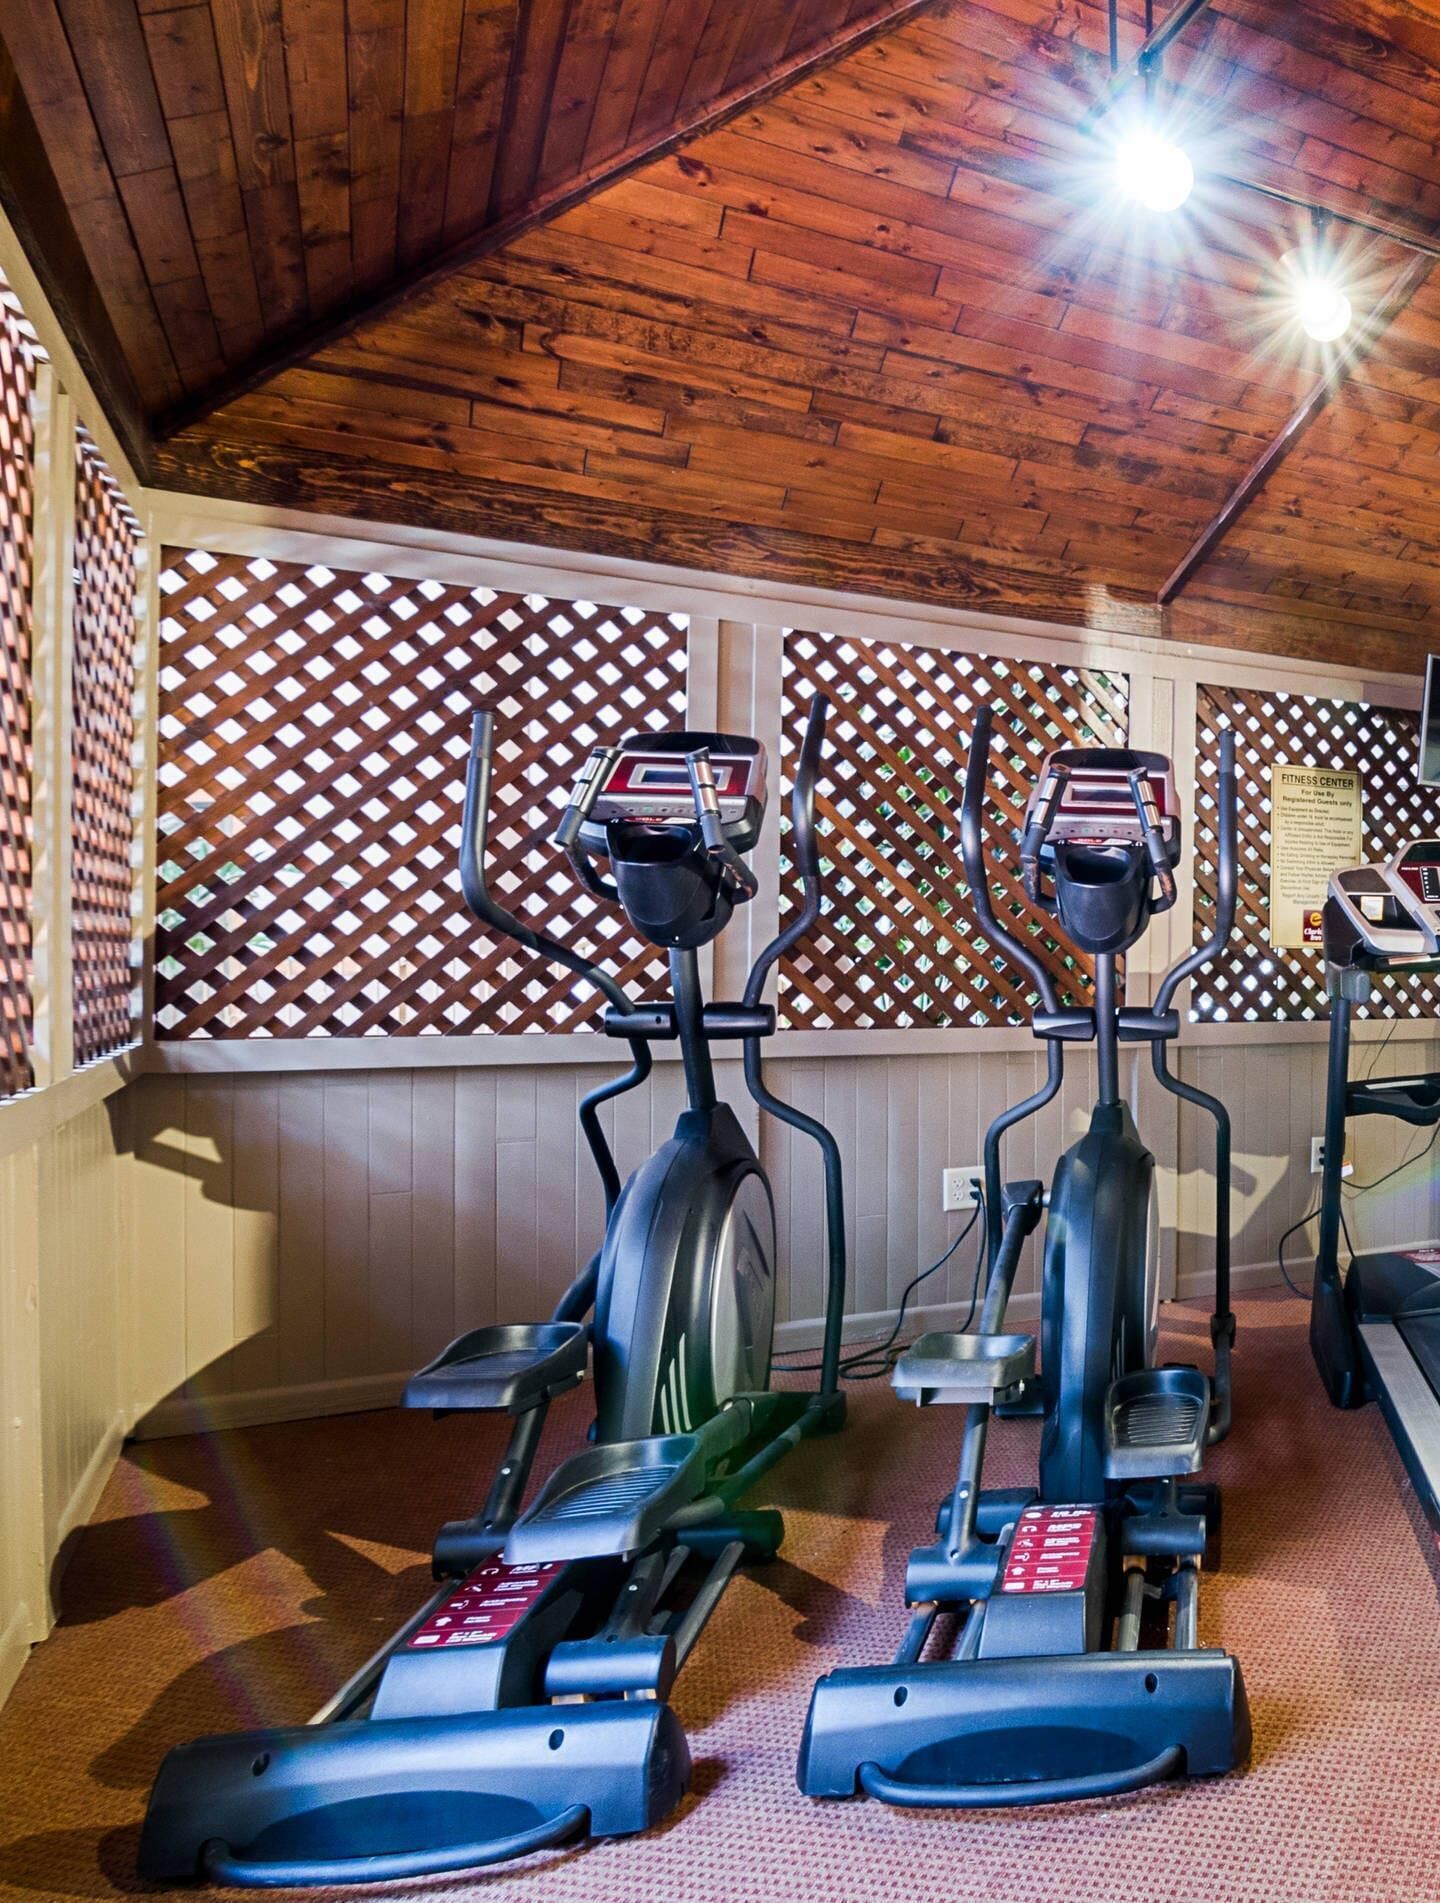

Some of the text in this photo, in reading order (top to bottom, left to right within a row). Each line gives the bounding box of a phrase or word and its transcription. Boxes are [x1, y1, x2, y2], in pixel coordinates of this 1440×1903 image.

[1281, 774, 1354, 788] FITNESS CENTER
[1282, 795, 1316, 805] Registered
